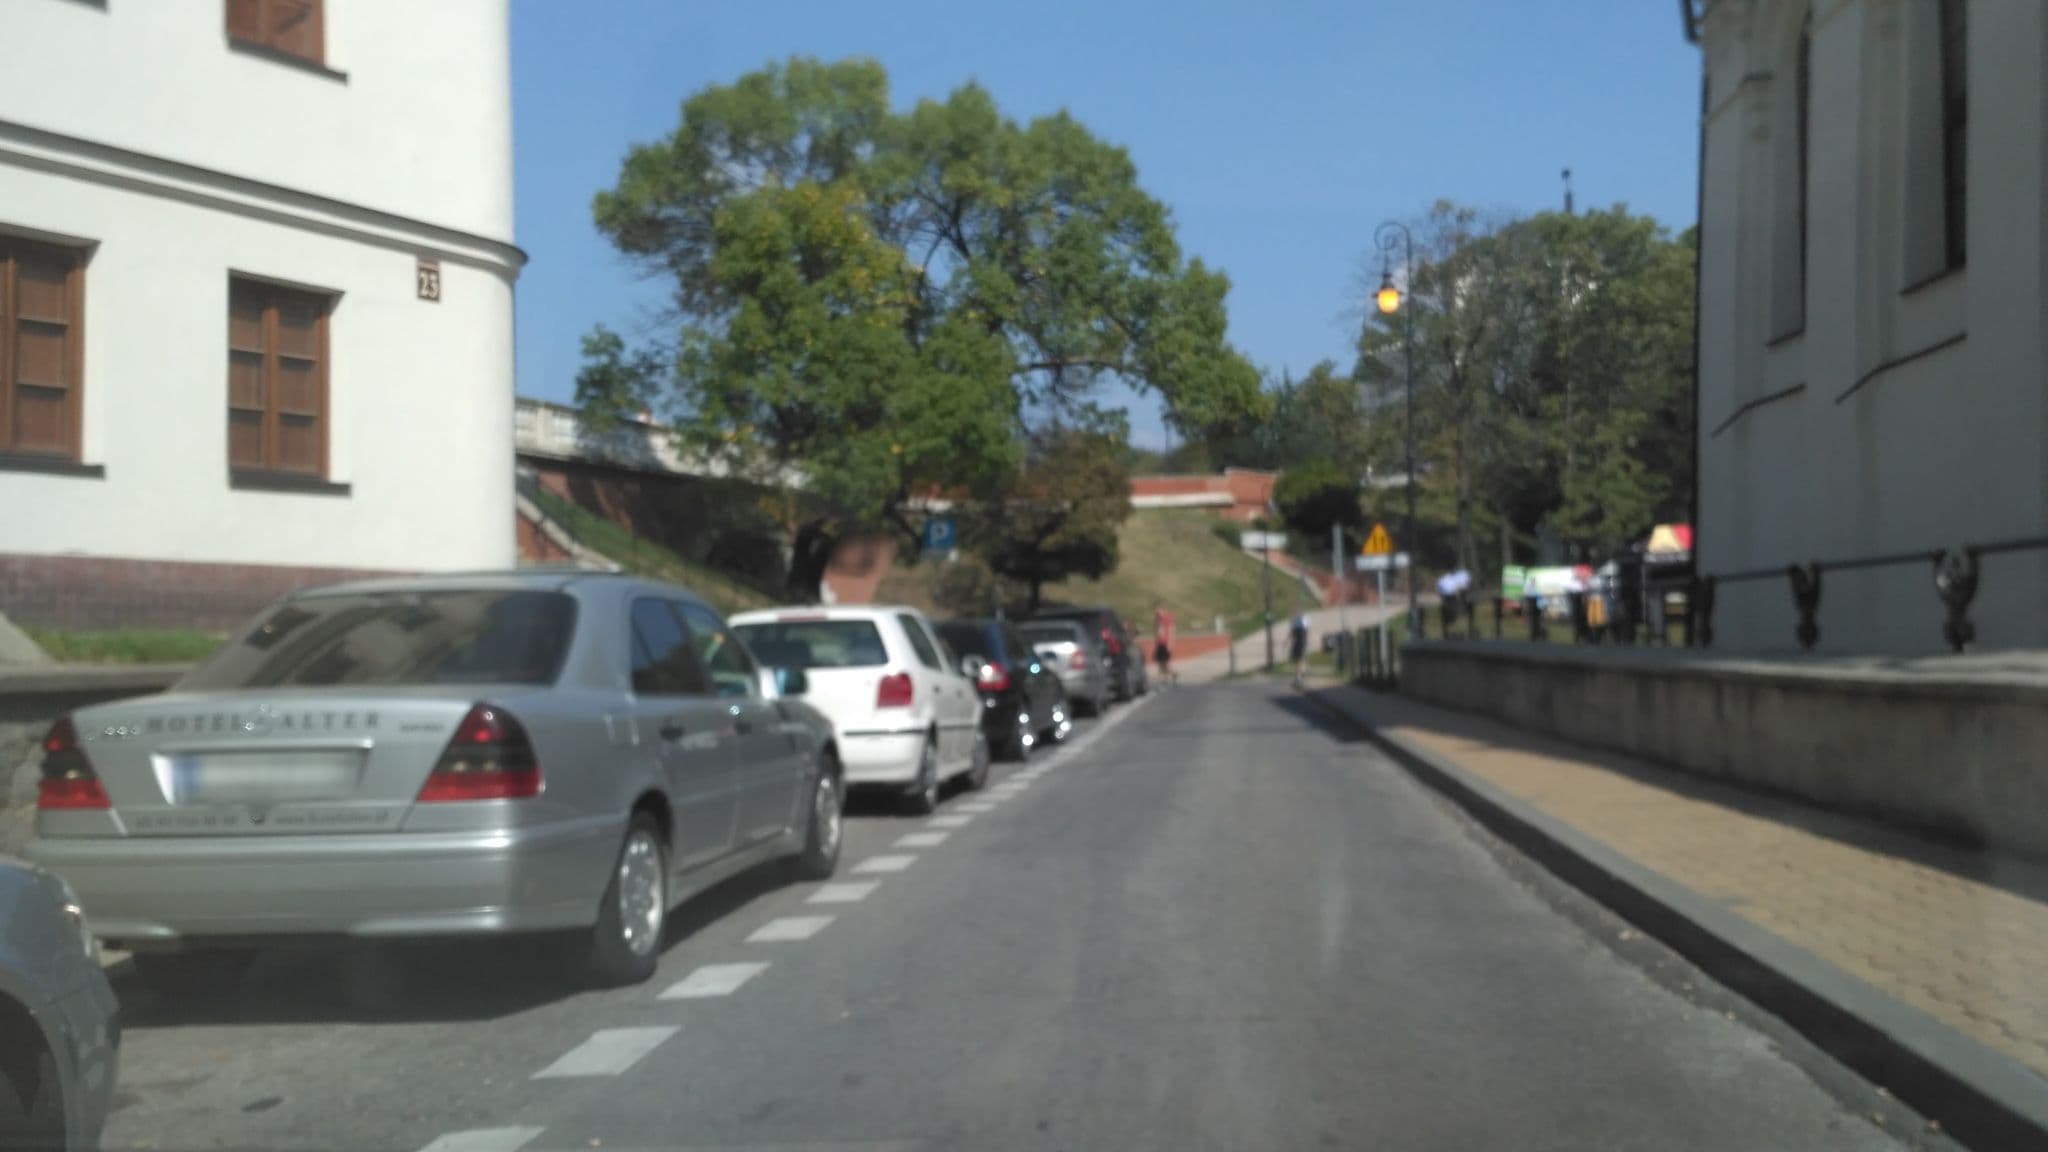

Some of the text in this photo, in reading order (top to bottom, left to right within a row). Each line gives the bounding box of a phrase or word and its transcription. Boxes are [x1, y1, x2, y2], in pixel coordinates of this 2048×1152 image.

[930, 522, 948, 545] P
[147, 711, 247, 733] HOTEL
[281, 709, 380, 731] ALTER
